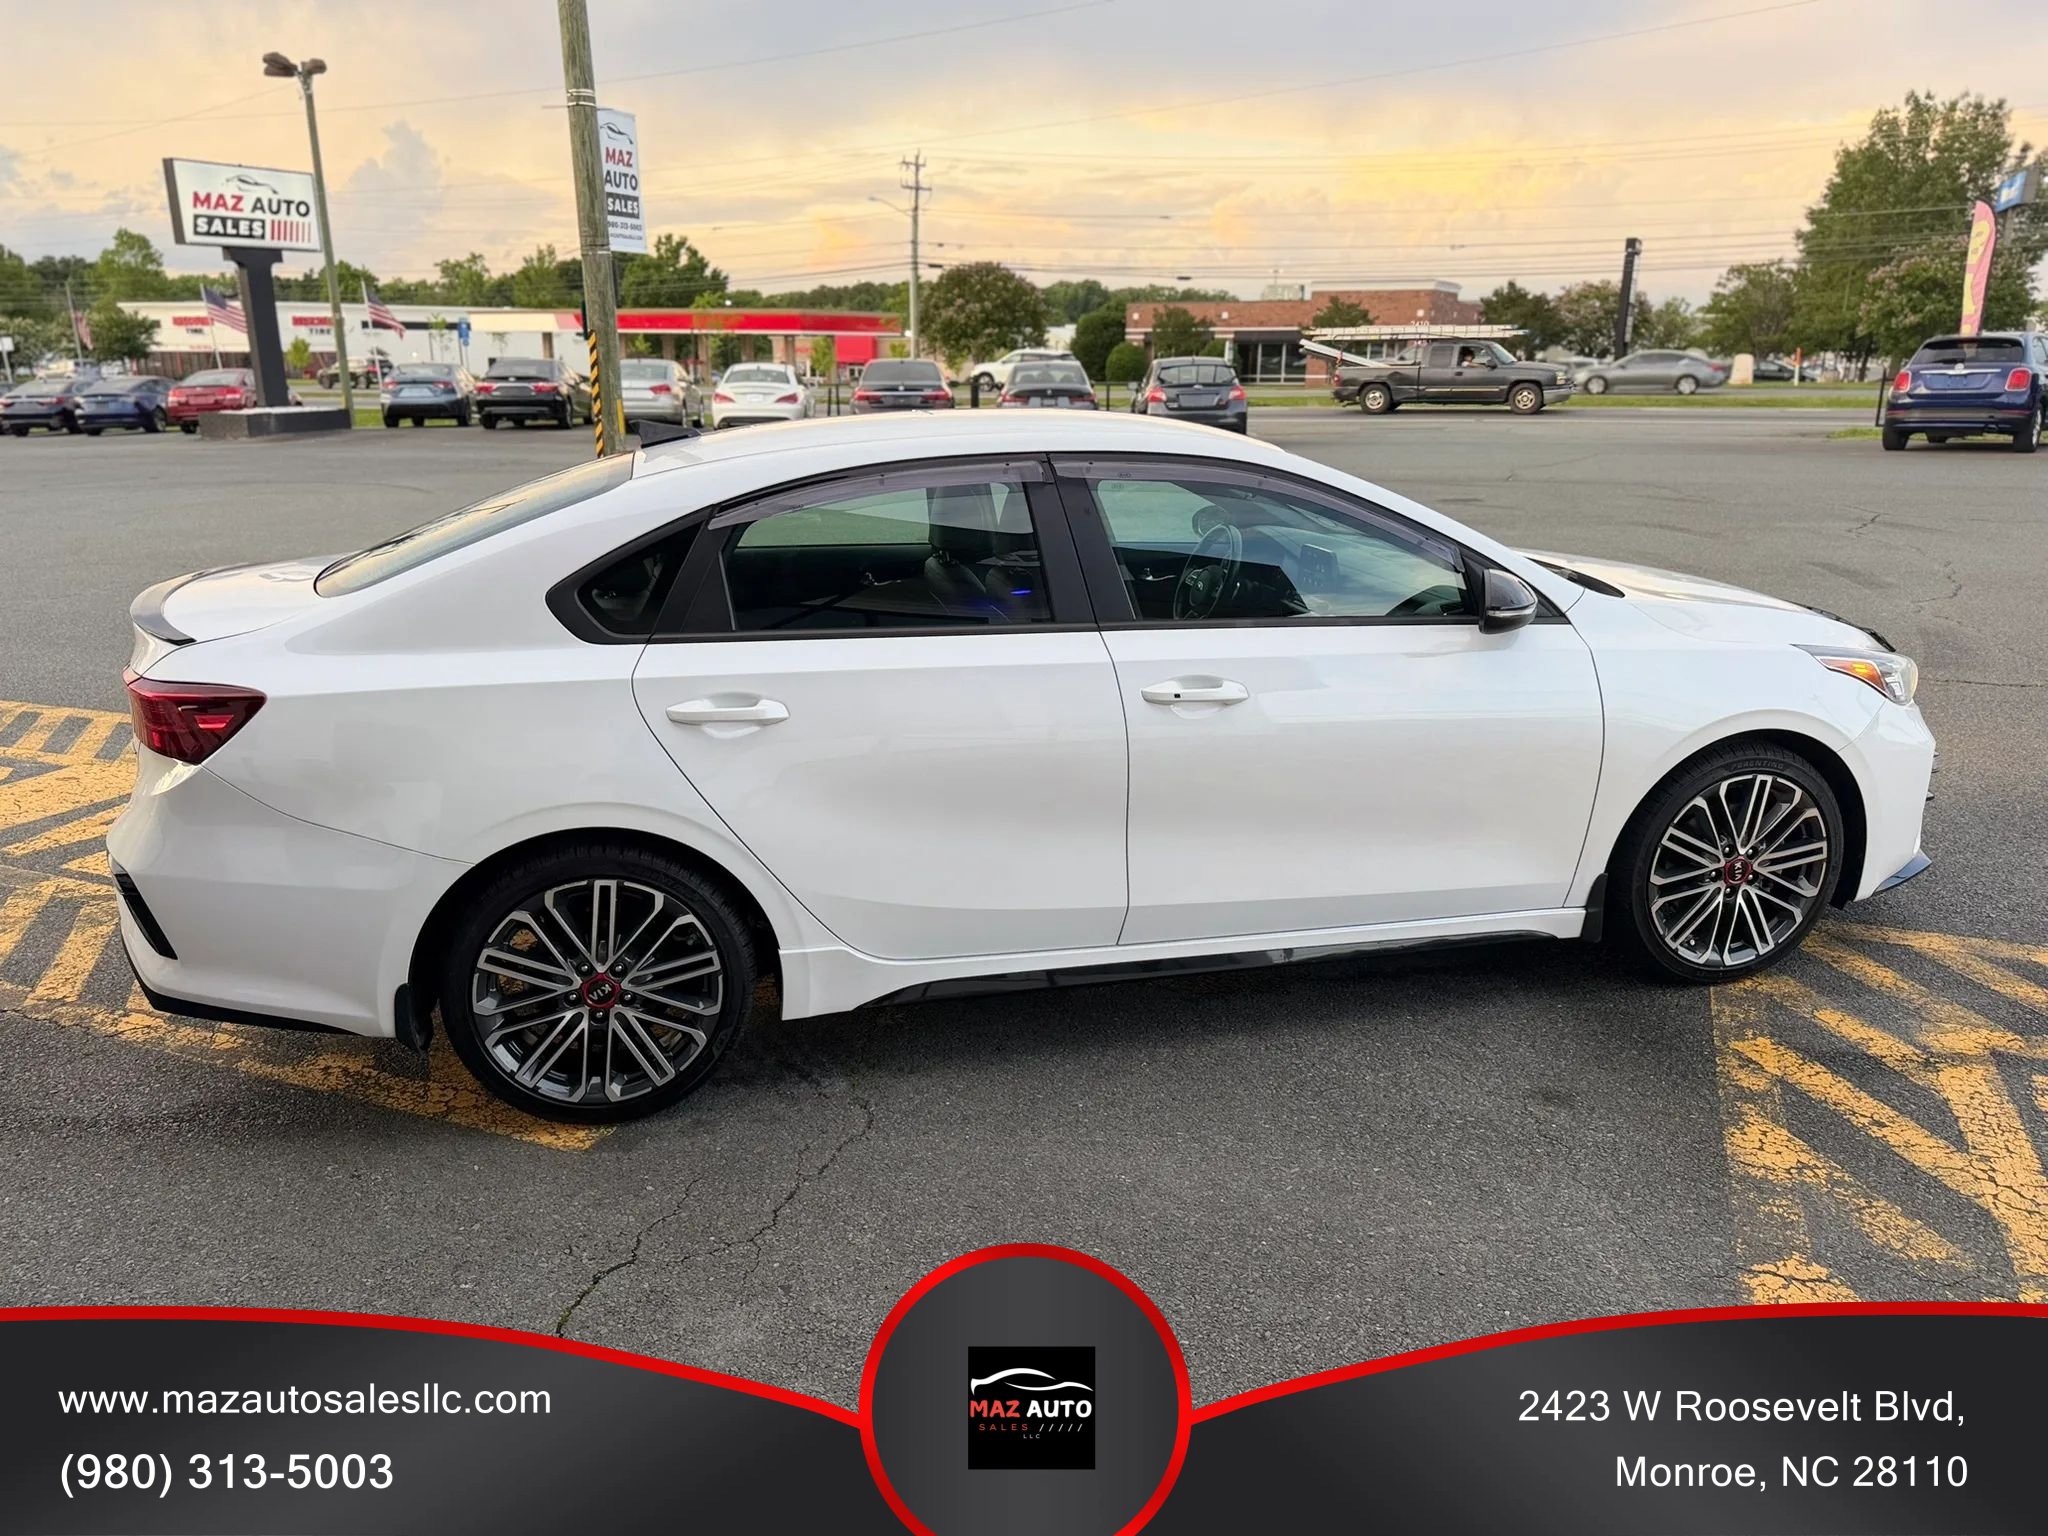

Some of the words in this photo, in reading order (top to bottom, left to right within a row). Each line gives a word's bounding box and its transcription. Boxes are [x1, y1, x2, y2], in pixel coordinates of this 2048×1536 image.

[605, 146, 633, 168] MAZ
[604, 170, 638, 191] AUTO
[192, 191, 244, 212] MAZ
[251, 197, 310, 217] AUTO
[607, 198, 639, 214] SALES
[195, 217, 264, 238] SALES
[589, 984, 612, 1000] KIA
